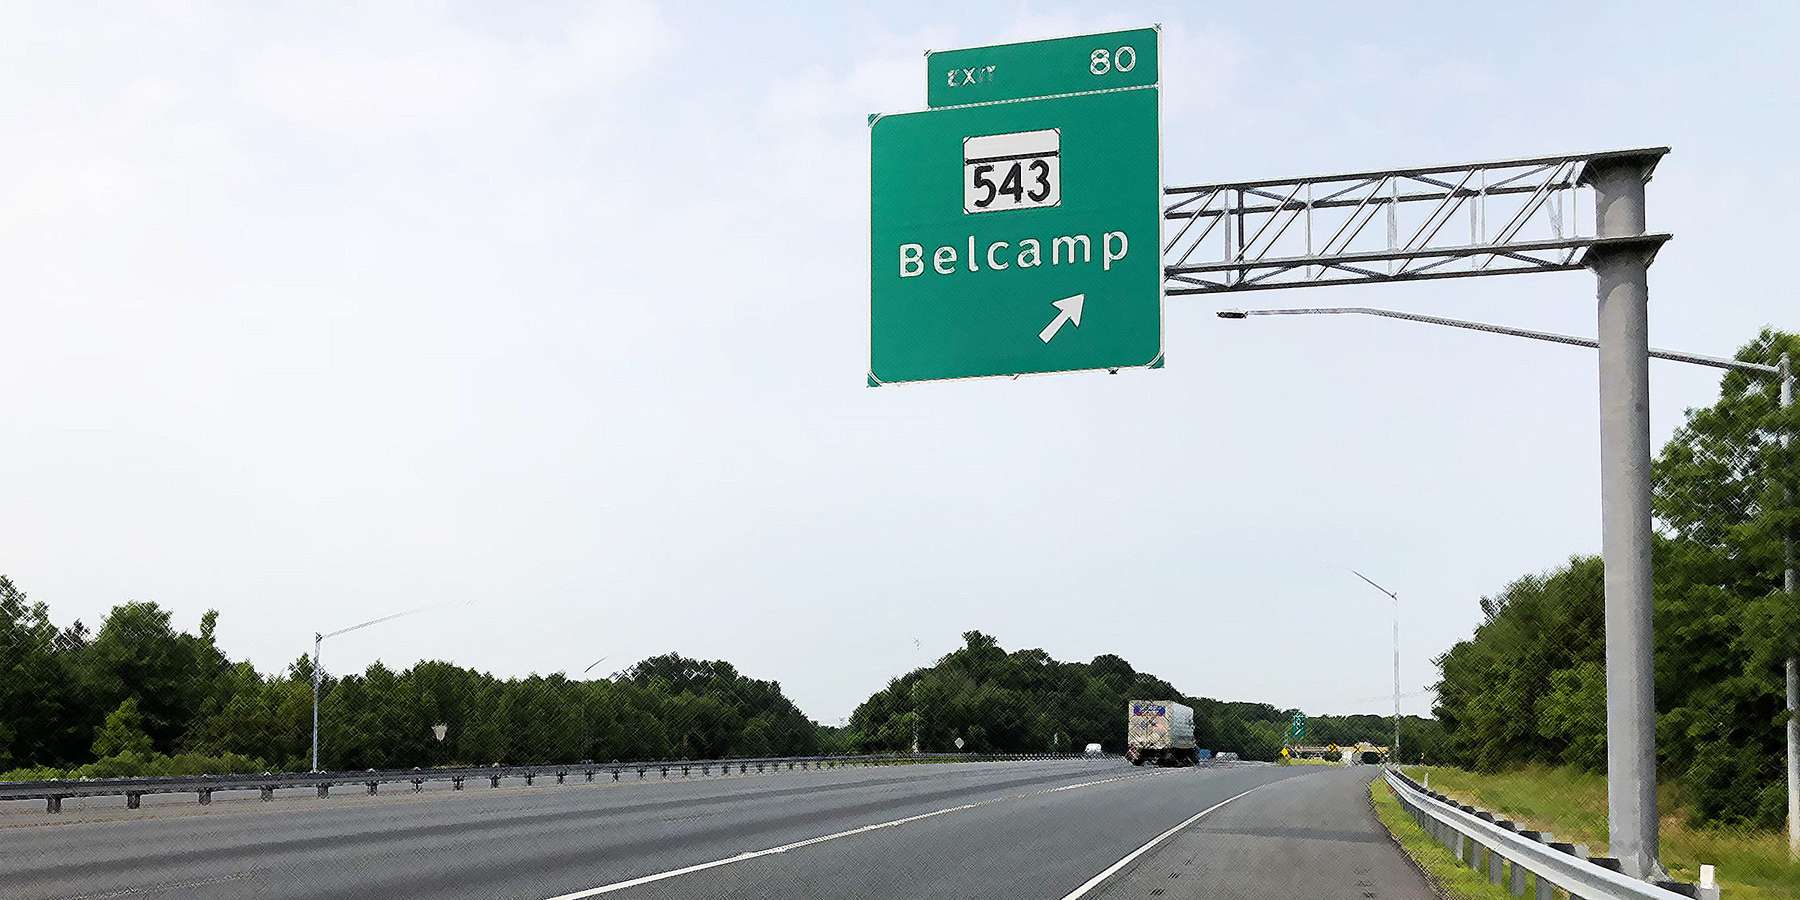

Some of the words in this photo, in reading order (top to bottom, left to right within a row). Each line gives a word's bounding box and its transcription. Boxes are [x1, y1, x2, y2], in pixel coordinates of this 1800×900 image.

[1089, 46, 1136, 75] 80
[973, 159, 1051, 208] 543
[899, 230, 1128, 278] Belcamp
